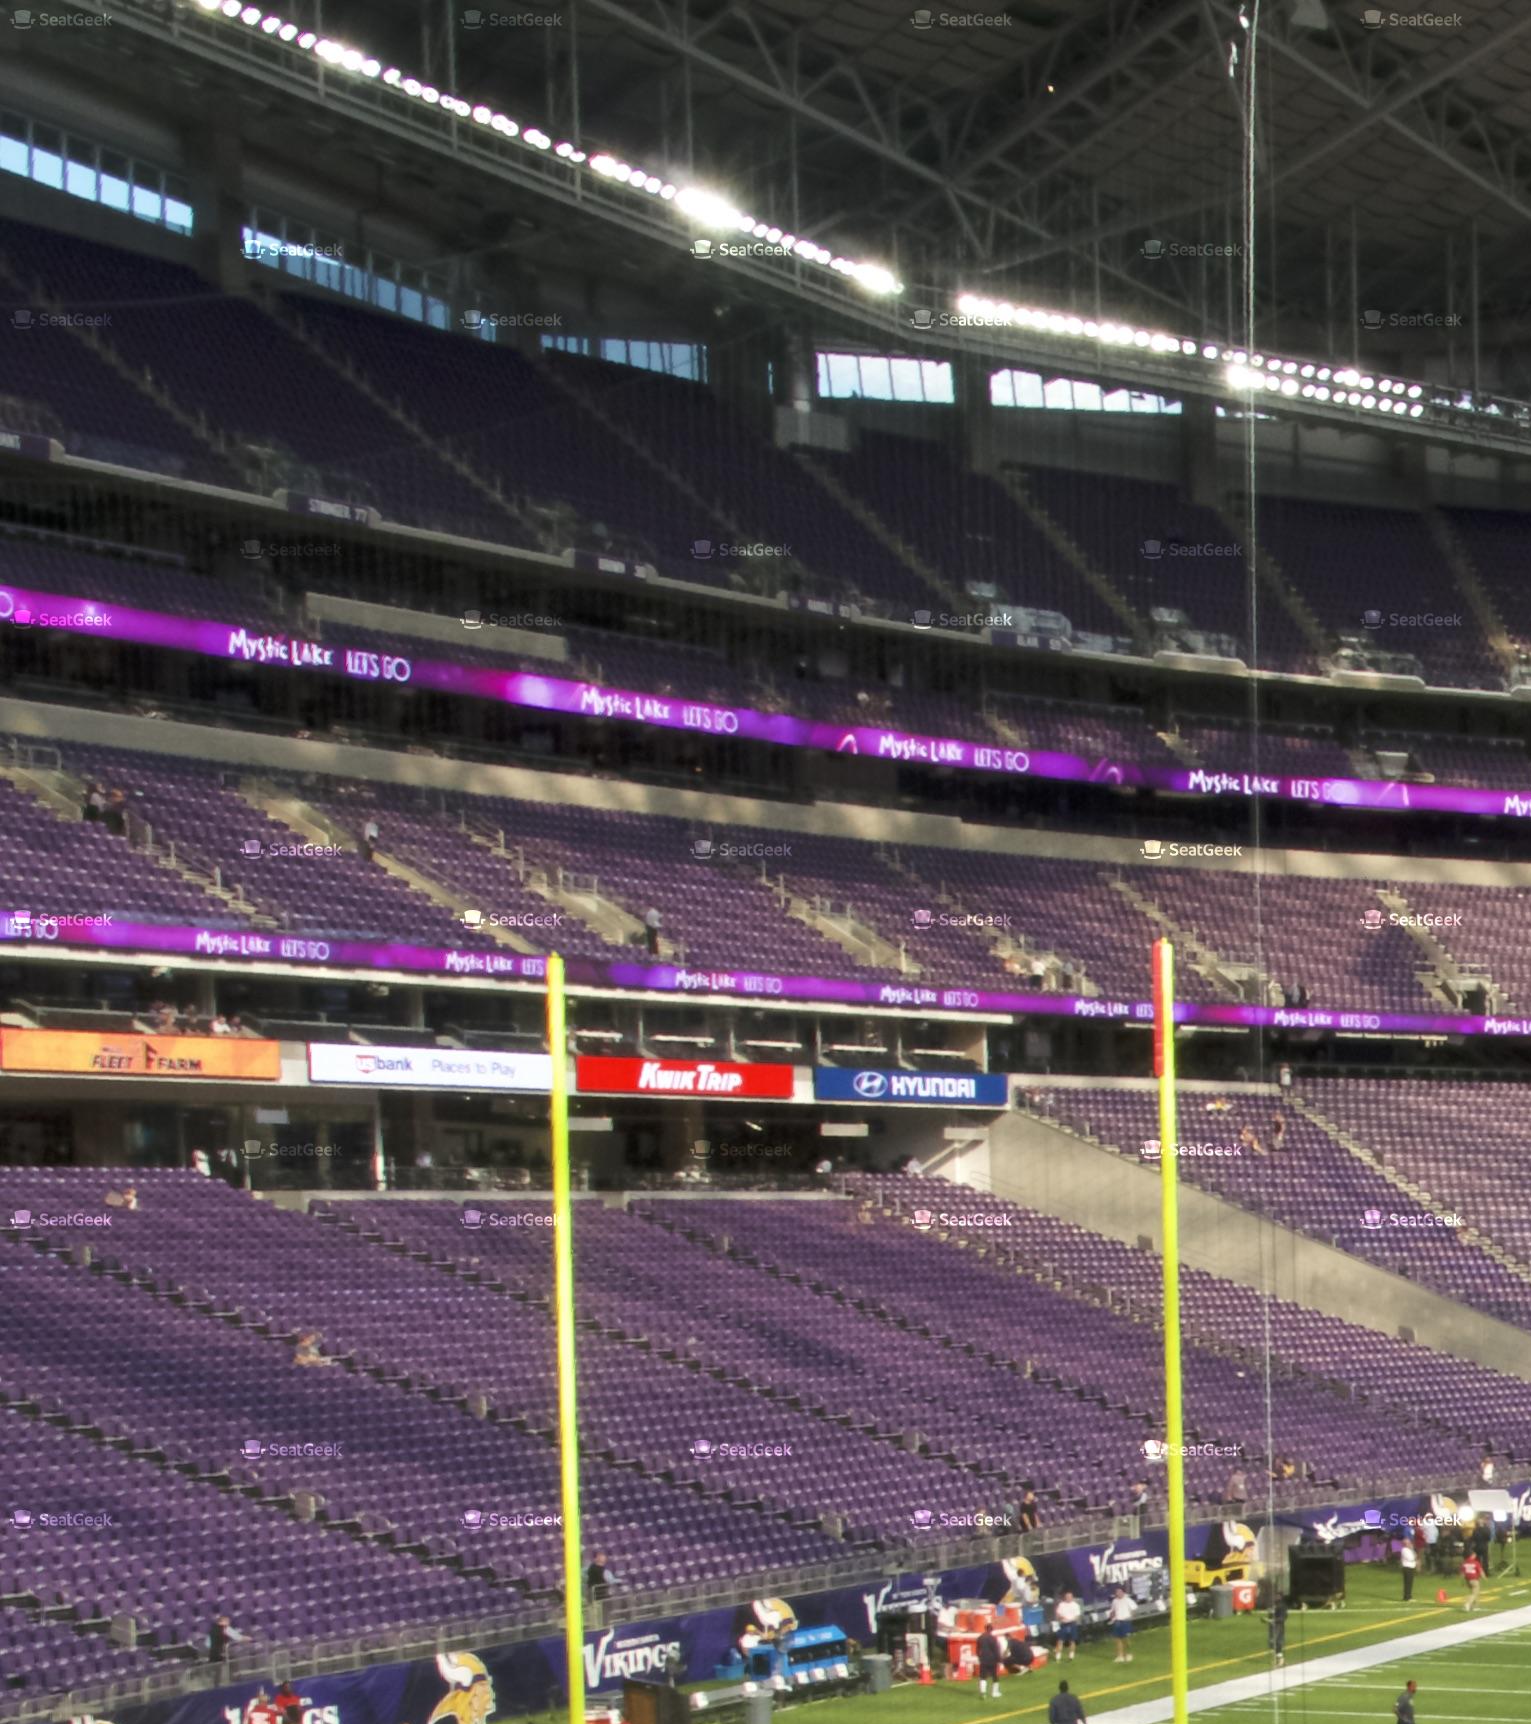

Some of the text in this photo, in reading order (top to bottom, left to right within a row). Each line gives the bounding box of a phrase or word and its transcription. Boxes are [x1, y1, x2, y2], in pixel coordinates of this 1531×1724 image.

[432, 1058, 470, 1073] Places
[475, 1062, 487, 1074] to
[491, 1061, 517, 1078] Play
[891, 1077, 976, 1099] HYUNDAI
